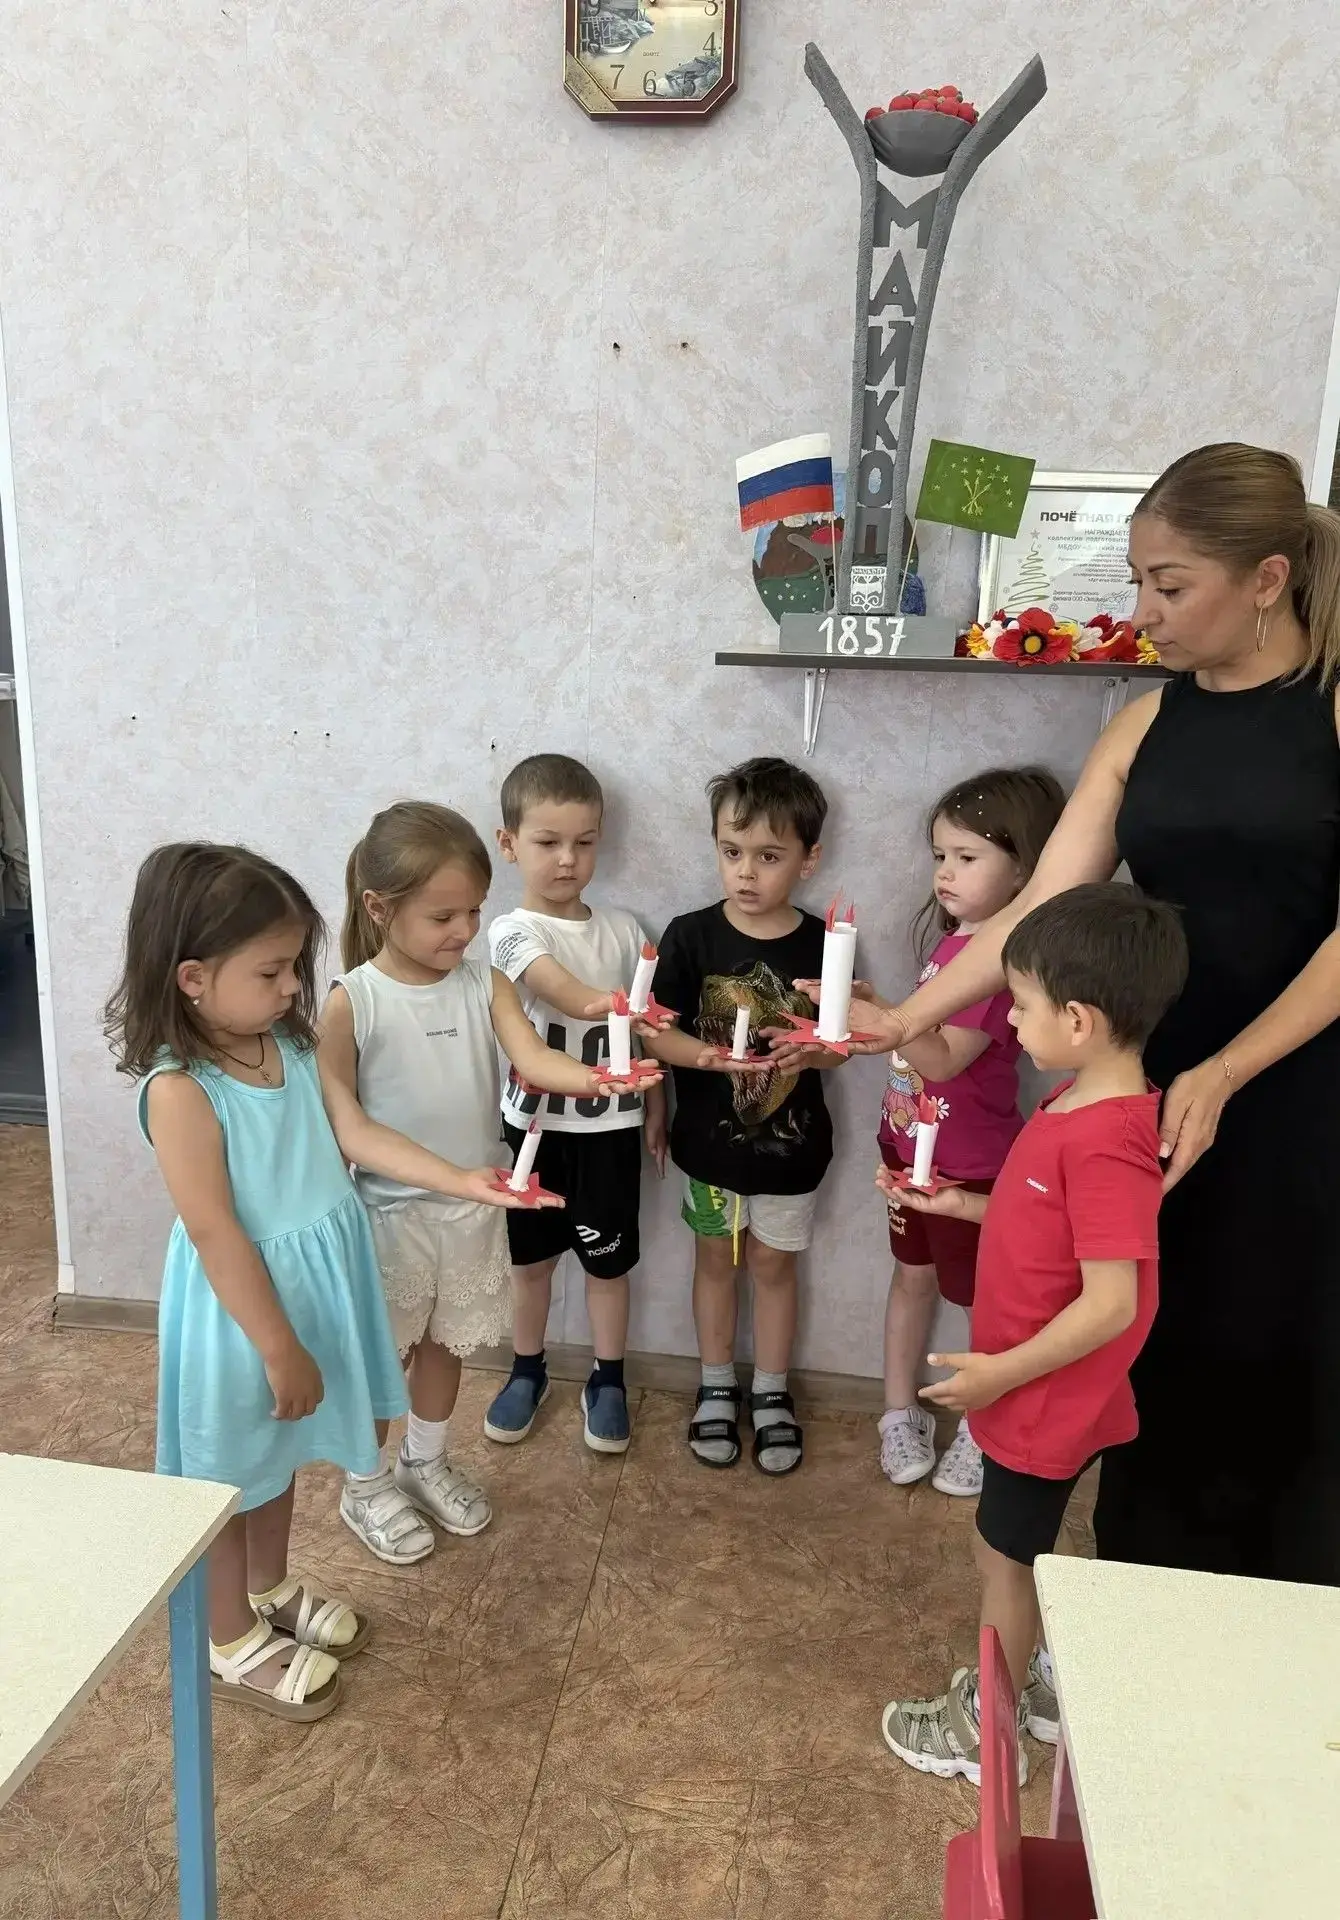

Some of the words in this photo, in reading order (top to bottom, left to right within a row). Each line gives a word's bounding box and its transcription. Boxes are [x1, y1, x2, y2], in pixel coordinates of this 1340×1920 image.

[703, 32, 718, 57] 4
[610, 64, 625, 90] 7
[643, 70, 658, 96] 6
[1040, 511, 1114, 523] ПОЧЁТНАЯ
[1085, 536, 1128, 544] подготовите
[817, 616, 907, 656] 1857
